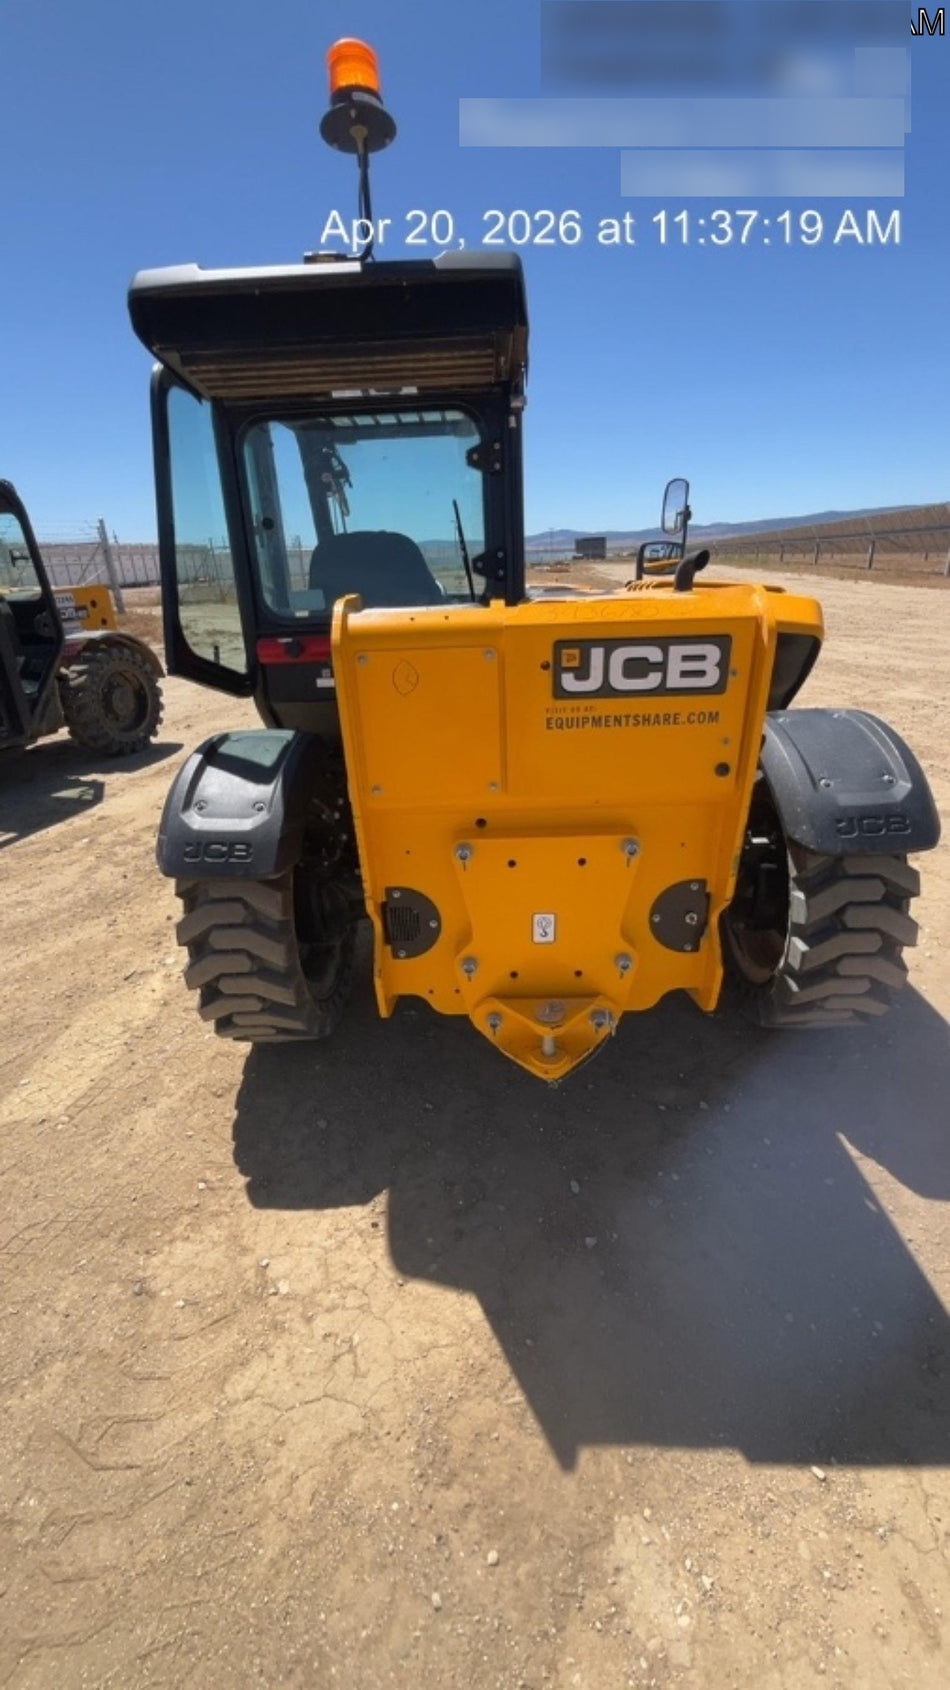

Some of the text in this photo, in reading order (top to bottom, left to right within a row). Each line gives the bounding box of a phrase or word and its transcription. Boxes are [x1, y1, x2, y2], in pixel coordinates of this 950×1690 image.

[561, 643, 722, 692] JCB
[545, 711, 720, 730] EQUIPMENTSHARE.COM
[835, 814, 912, 838] JCB
[184, 841, 253, 862] JCB
